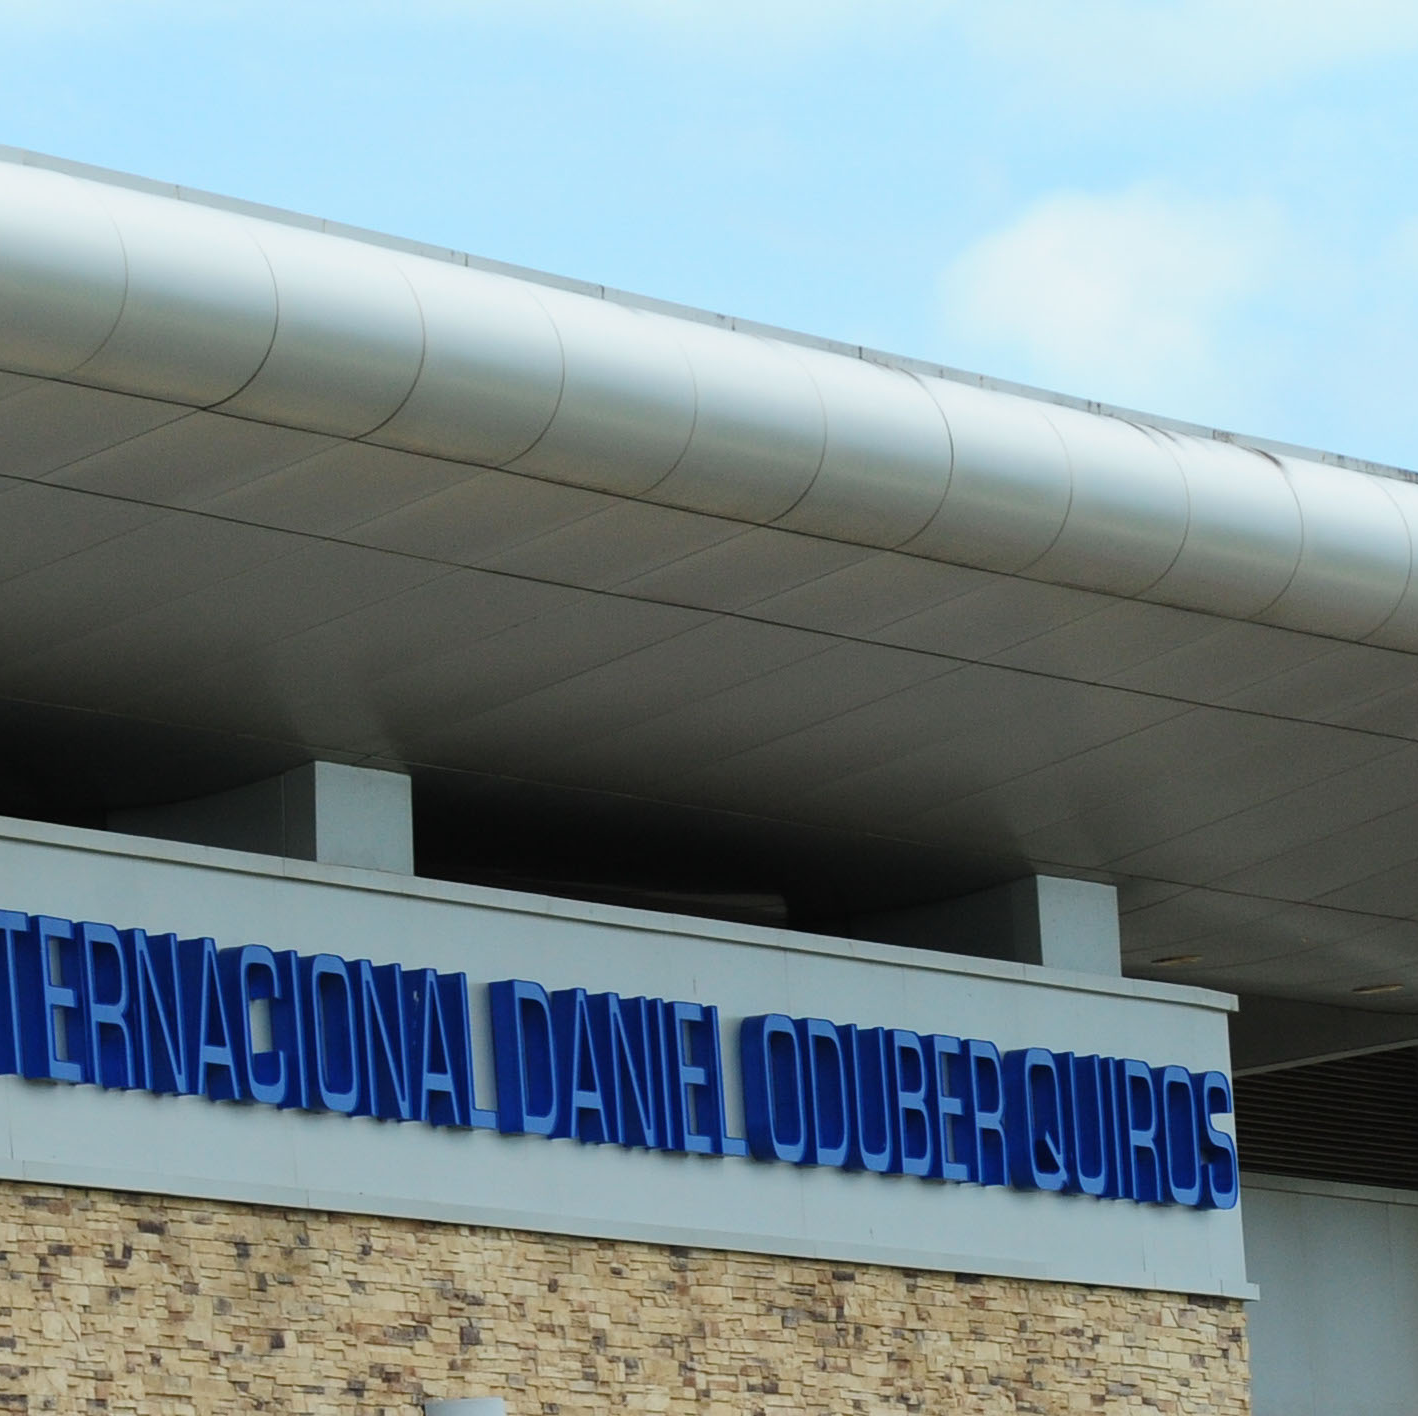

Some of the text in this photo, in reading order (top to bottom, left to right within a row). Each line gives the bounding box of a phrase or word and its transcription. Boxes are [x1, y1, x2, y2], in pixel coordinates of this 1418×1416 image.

[489, 977, 747, 1158] DANIEL
[741, 1012, 1008, 1186] ODUBER
[1006, 1046, 1238, 1210] QUIROS
